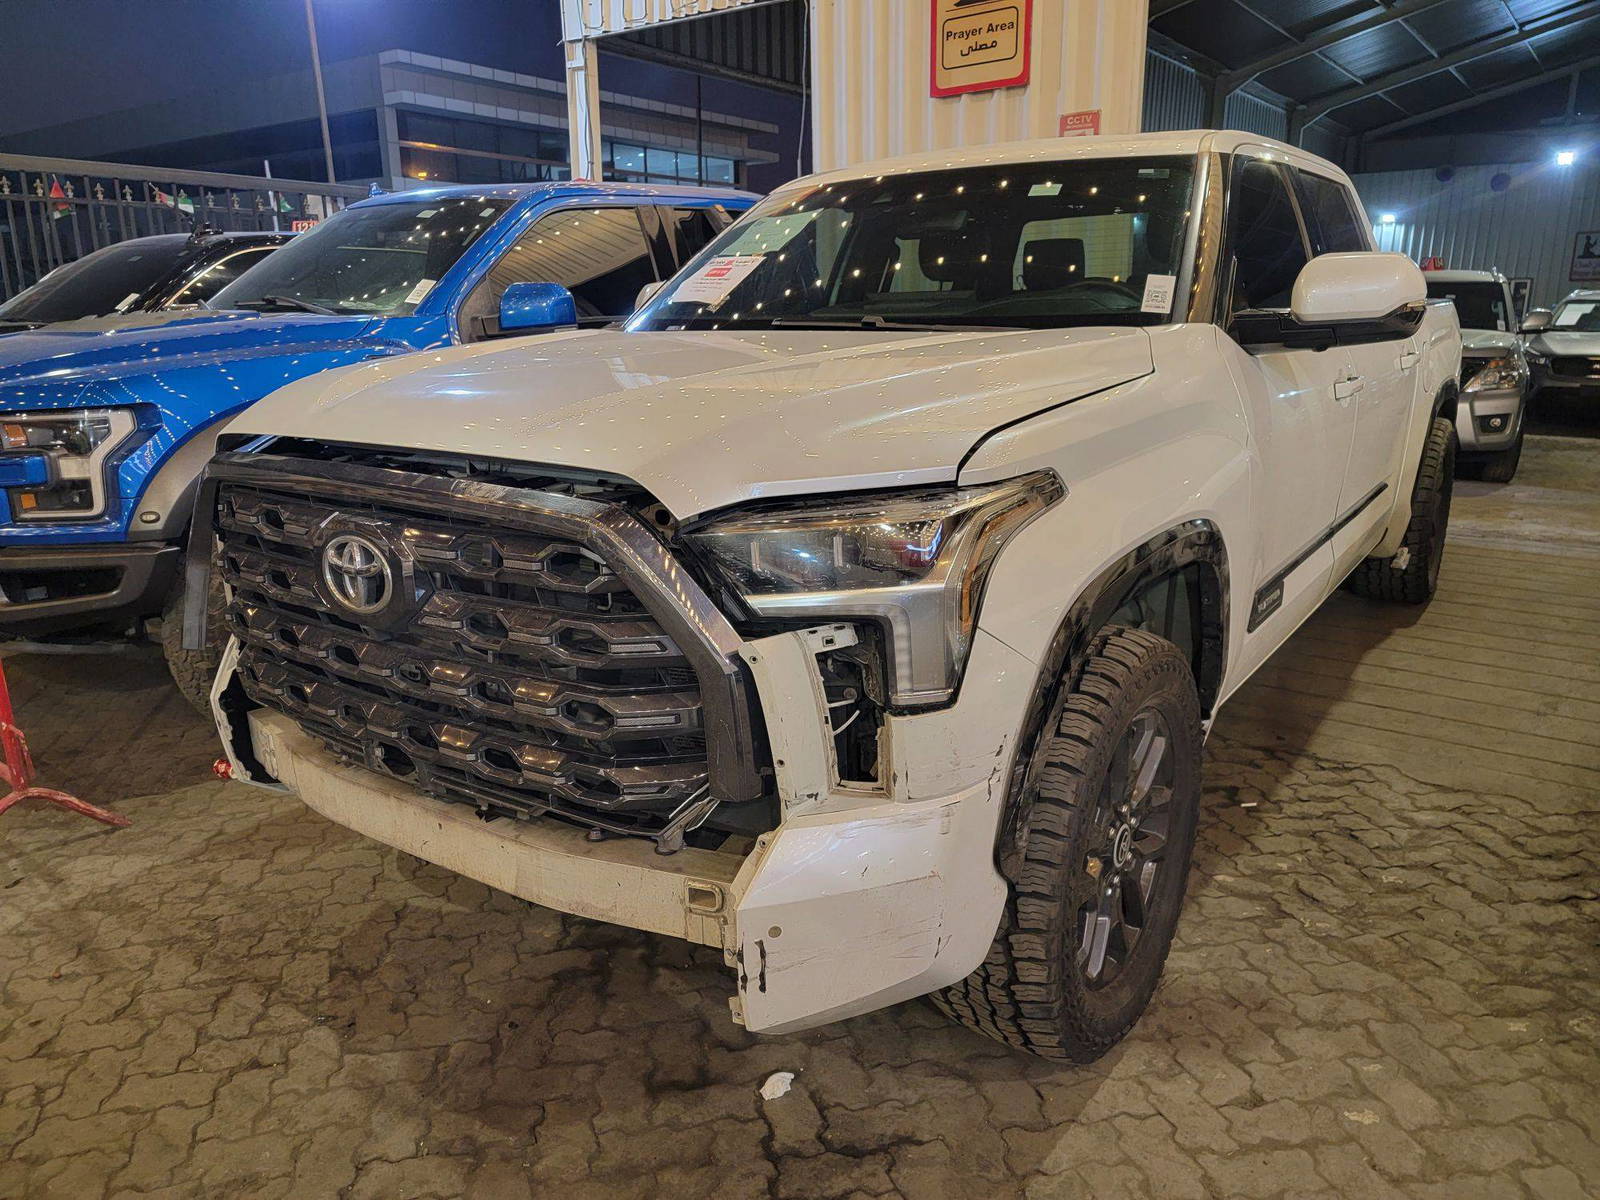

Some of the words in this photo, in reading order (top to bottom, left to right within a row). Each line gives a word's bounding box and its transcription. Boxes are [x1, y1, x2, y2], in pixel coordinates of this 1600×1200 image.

[945, 27, 983, 41] Prayer
[986, 21, 1015, 34] Area
[960, 39, 998, 57] مصلى
[1067, 114, 1093, 125] CCTV
